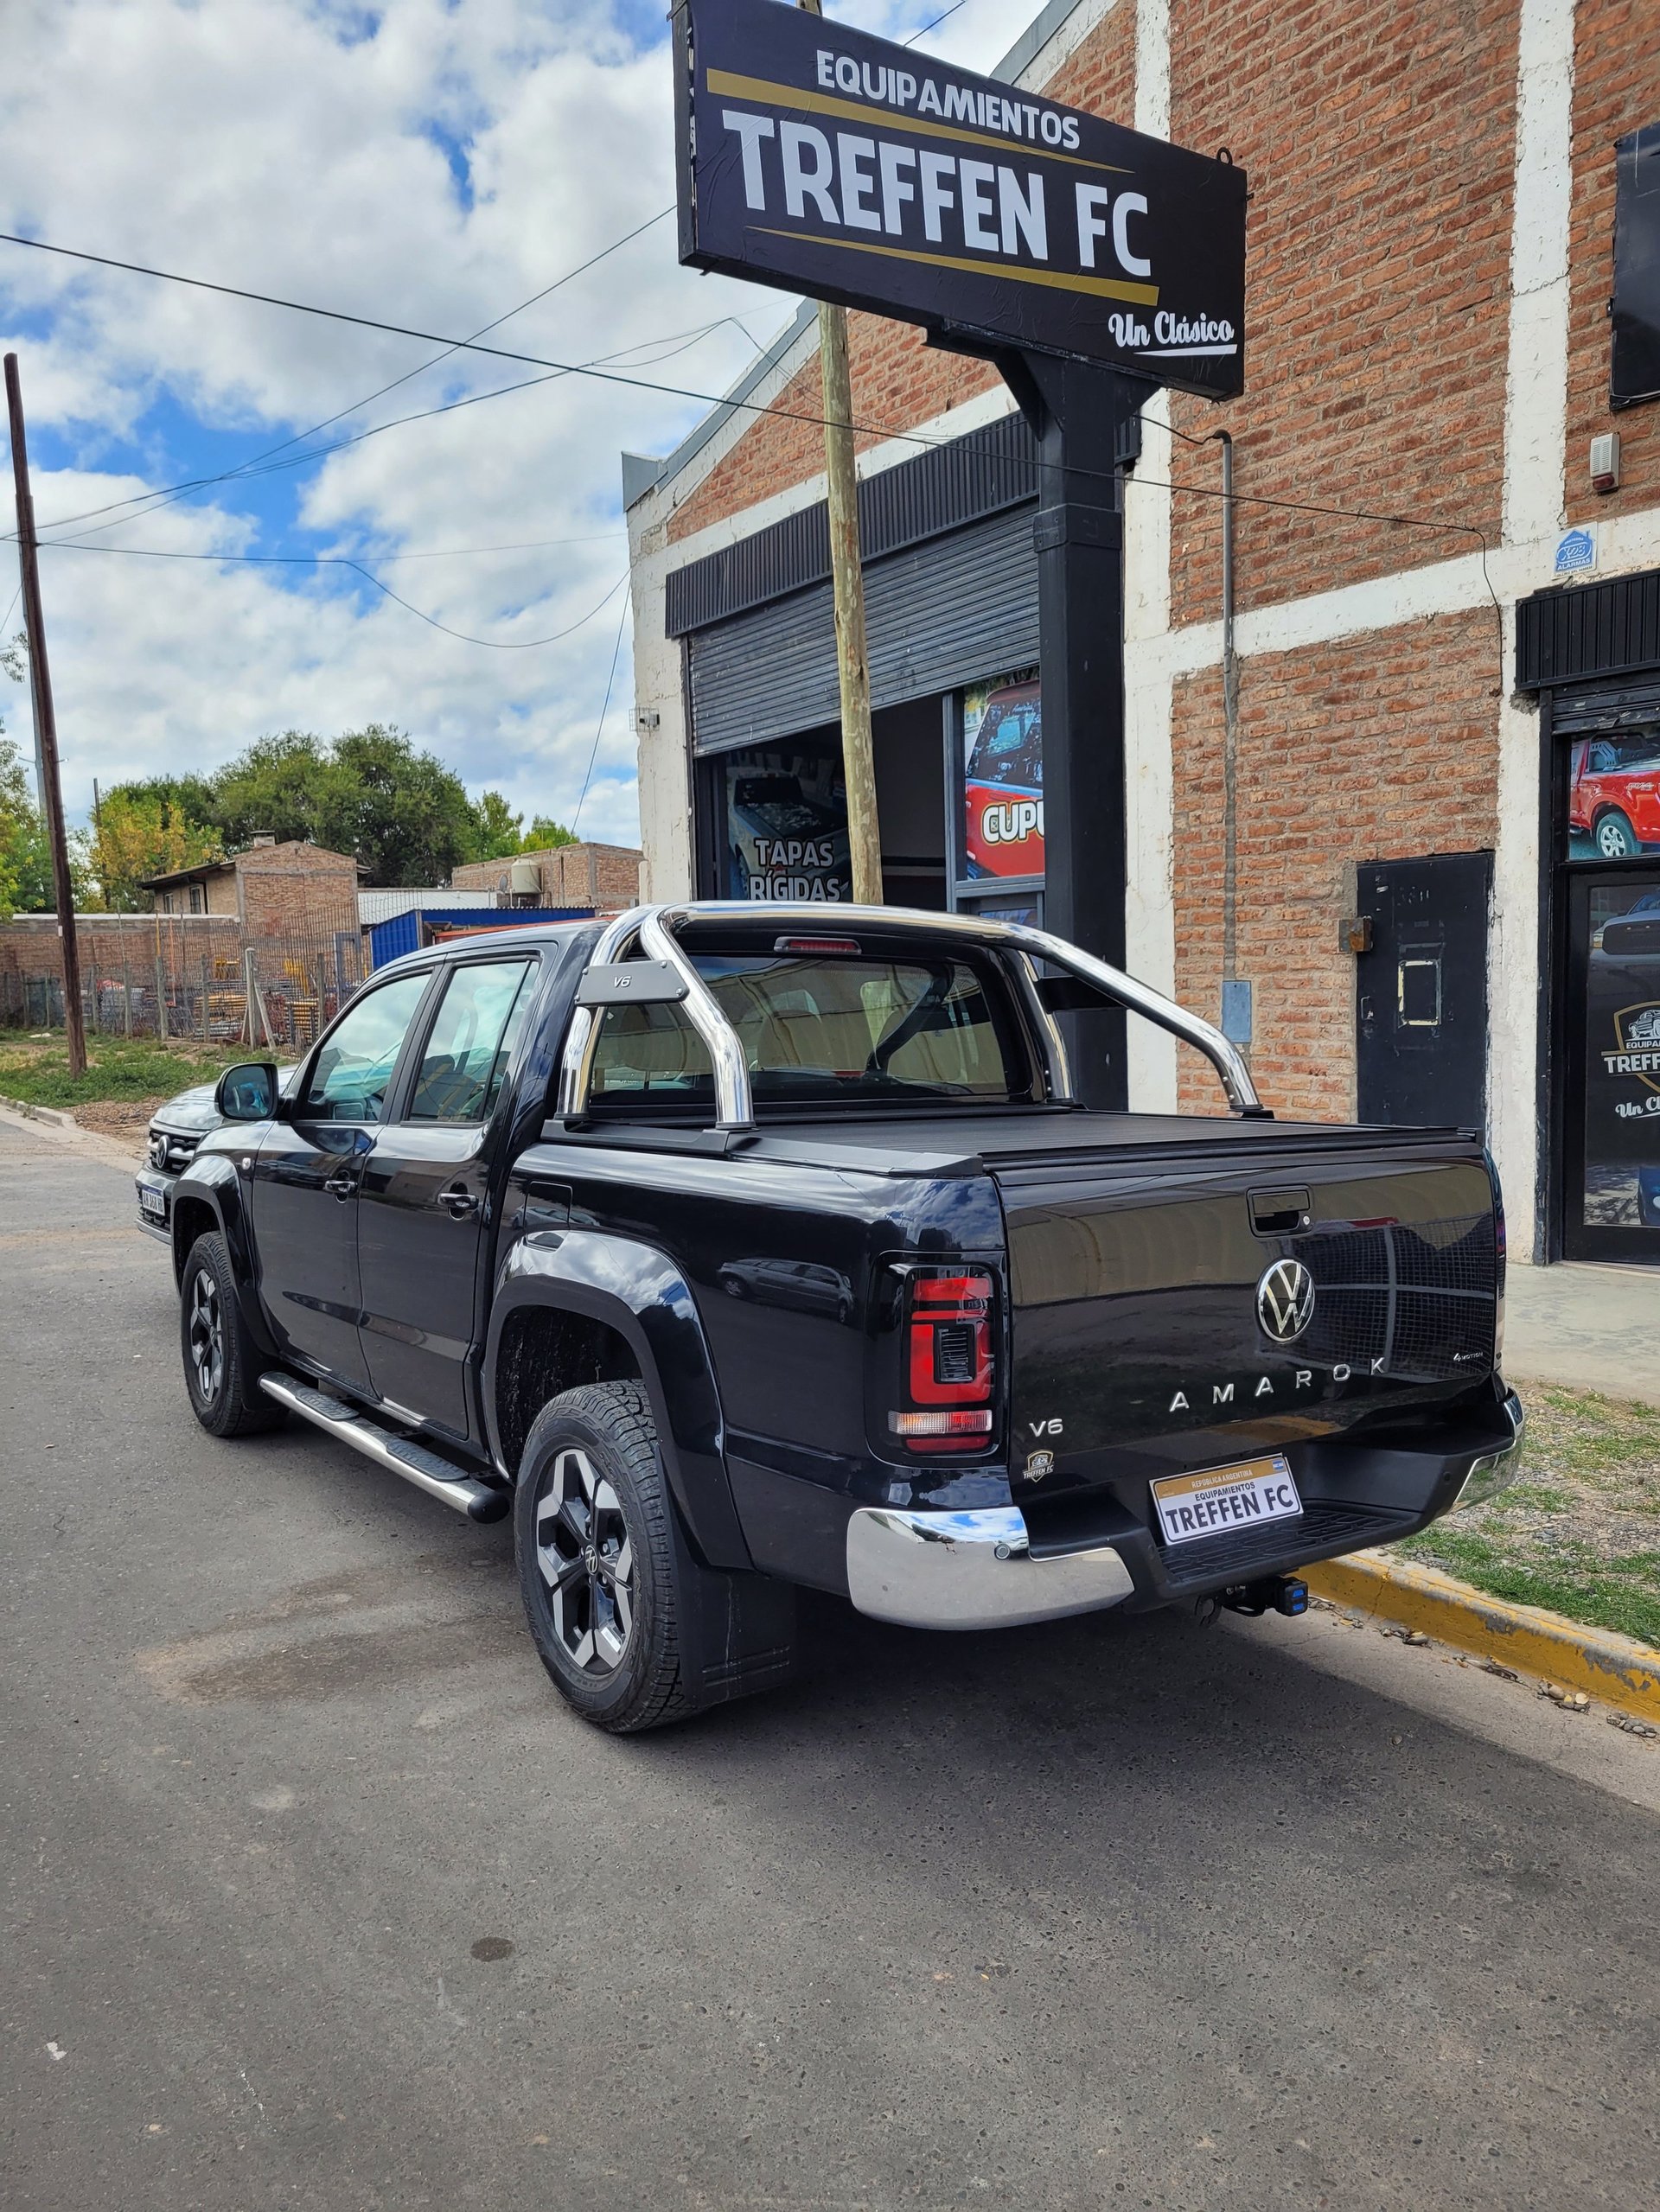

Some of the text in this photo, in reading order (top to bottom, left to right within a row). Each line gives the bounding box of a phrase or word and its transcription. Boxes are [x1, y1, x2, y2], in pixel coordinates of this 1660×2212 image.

[817, 50, 1080, 150] EQUIPAMIENTOS
[722, 109, 1152, 277] TREFFEN FC
[1108, 309, 1235, 348] Un Clásico
[1557, 558, 1590, 571] ALARMAS
[755, 839, 834, 867] TAPAS
[750, 870, 840, 901] RÍGIDAS
[614, 975, 632, 988] V6
[1615, 1102, 1644, 1118] Un
[1169, 1357, 1385, 1412] AMAROK
[1028, 1418, 1063, 1437] V6
[1195, 1482, 1255, 1501] EQUIPAMIENTOS
[1165, 1484, 1293, 1533] TREFFEN FC
